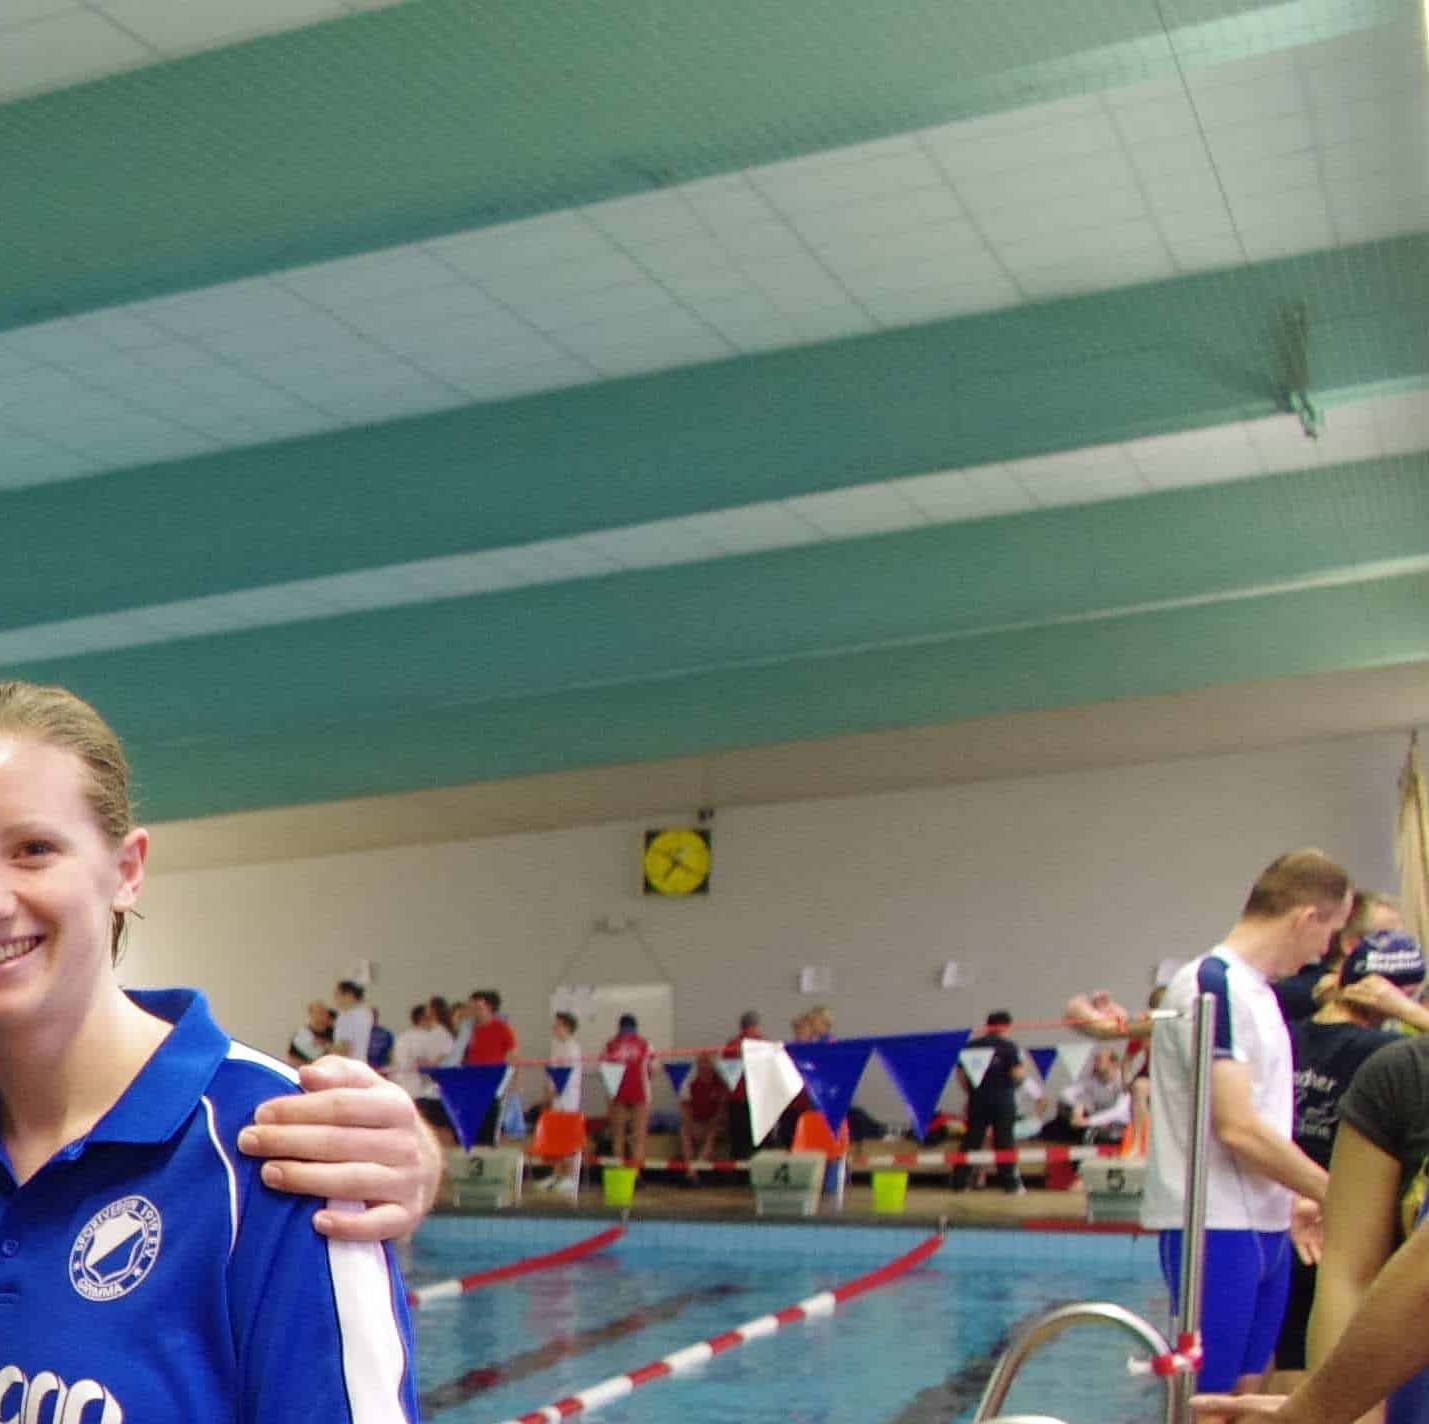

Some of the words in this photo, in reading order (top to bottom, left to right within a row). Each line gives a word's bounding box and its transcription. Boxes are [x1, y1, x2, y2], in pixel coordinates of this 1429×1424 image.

[469, 1156, 485, 1178] 3
[771, 1162, 791, 1187] 4
[1107, 1168, 1126, 1192] 5
